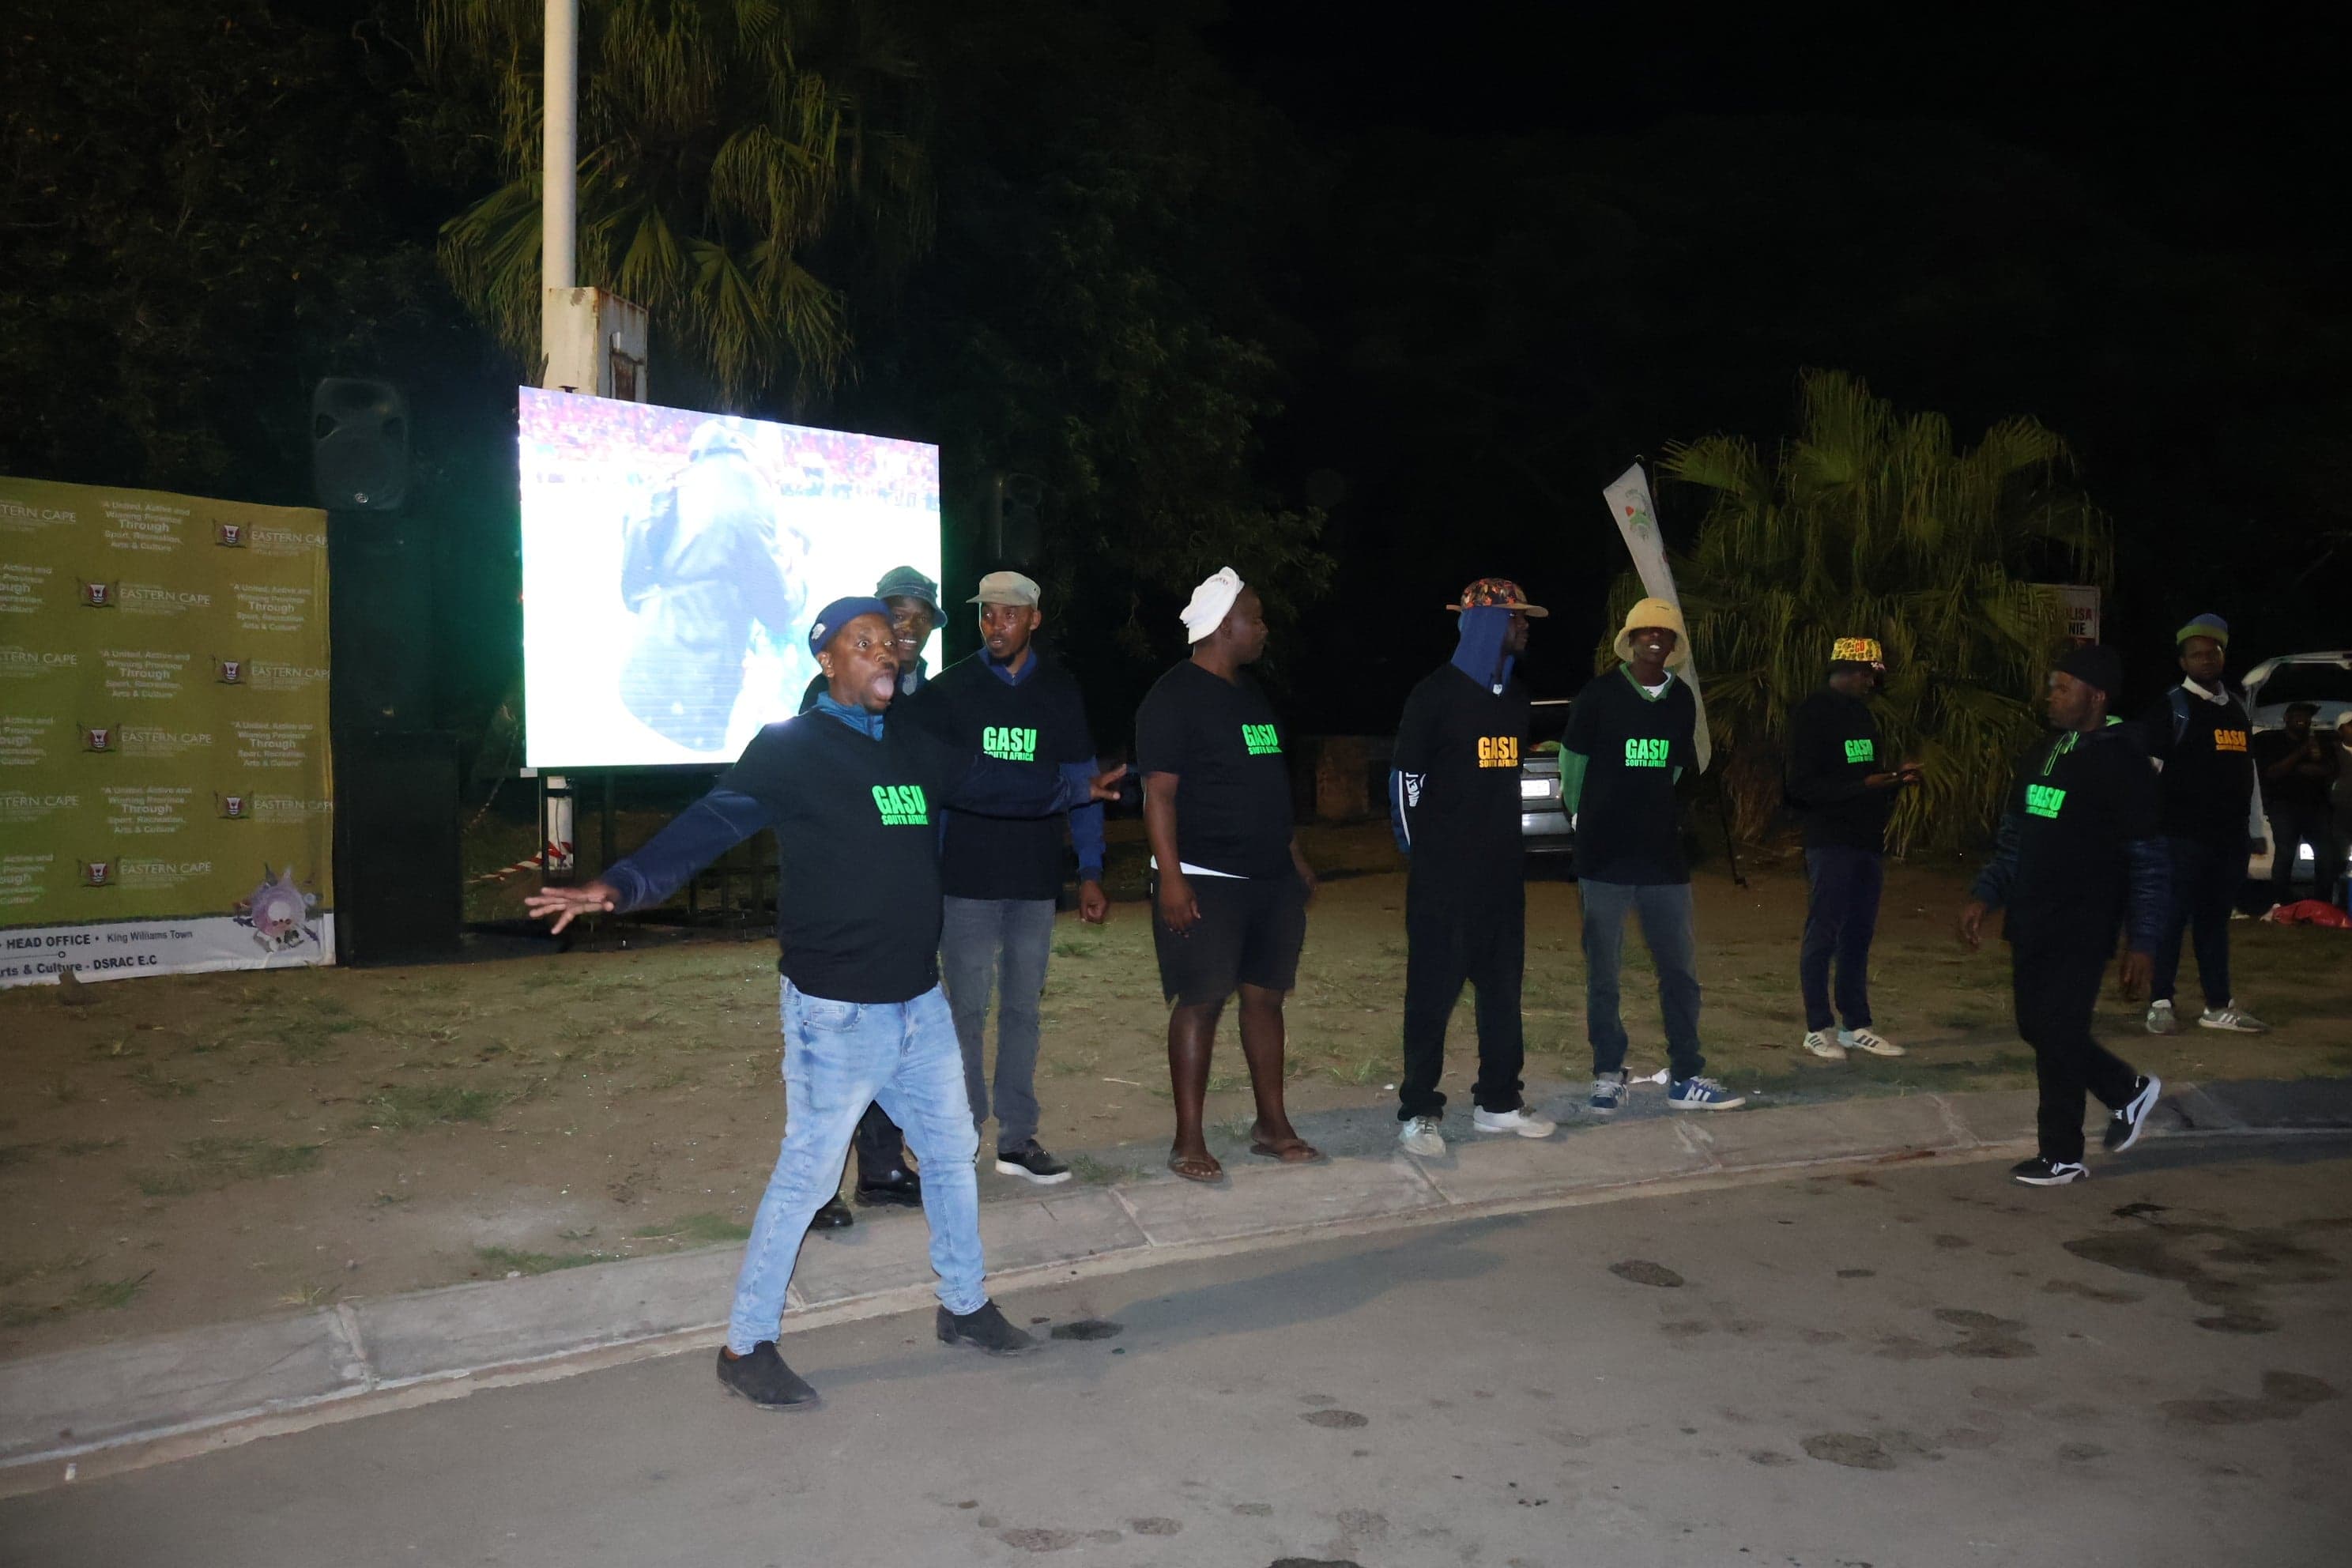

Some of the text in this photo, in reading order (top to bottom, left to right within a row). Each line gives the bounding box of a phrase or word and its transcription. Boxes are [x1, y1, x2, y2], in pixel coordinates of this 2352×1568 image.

[42, 509, 77, 522] CAPE
[119, 518, 169, 533] Through
[251, 530, 302, 543] EASTERN
[119, 588, 211, 606] EASTERN CAPE
[248, 601, 295, 615] Through
[0, 650, 77, 665] TERN CAPE
[119, 668, 171, 680] Through
[251, 665, 302, 677] EASTERN
[121, 732, 213, 744] EASTERN CAPE
[983, 726, 1037, 753] GASU
[1242, 724, 1279, 747] GASU
[2214, 729, 2247, 746] GASU
[250, 738, 296, 750] Through
[1478, 736, 1518, 760] GASU
[1625, 738, 1669, 760] GASU
[1009, 752, 1034, 762] AFRICA
[1479, 759, 1498, 768] SOUTH
[44, 795, 81, 806] CAPE
[872, 784, 927, 815] GASU
[2026, 784, 2067, 811] GASU
[121, 804, 172, 816] Through
[254, 800, 332, 811] EASTERN CAP
[881, 814, 908, 826] SOUTH
[120, 861, 212, 874] EASTERN CAPE
[6, 929, 193, 949] HEAD OFFICE King Williams Town
[24, 964, 32, 974] &
[93, 956, 134, 970] DSRAC
[138, 955, 157, 965] E.C
